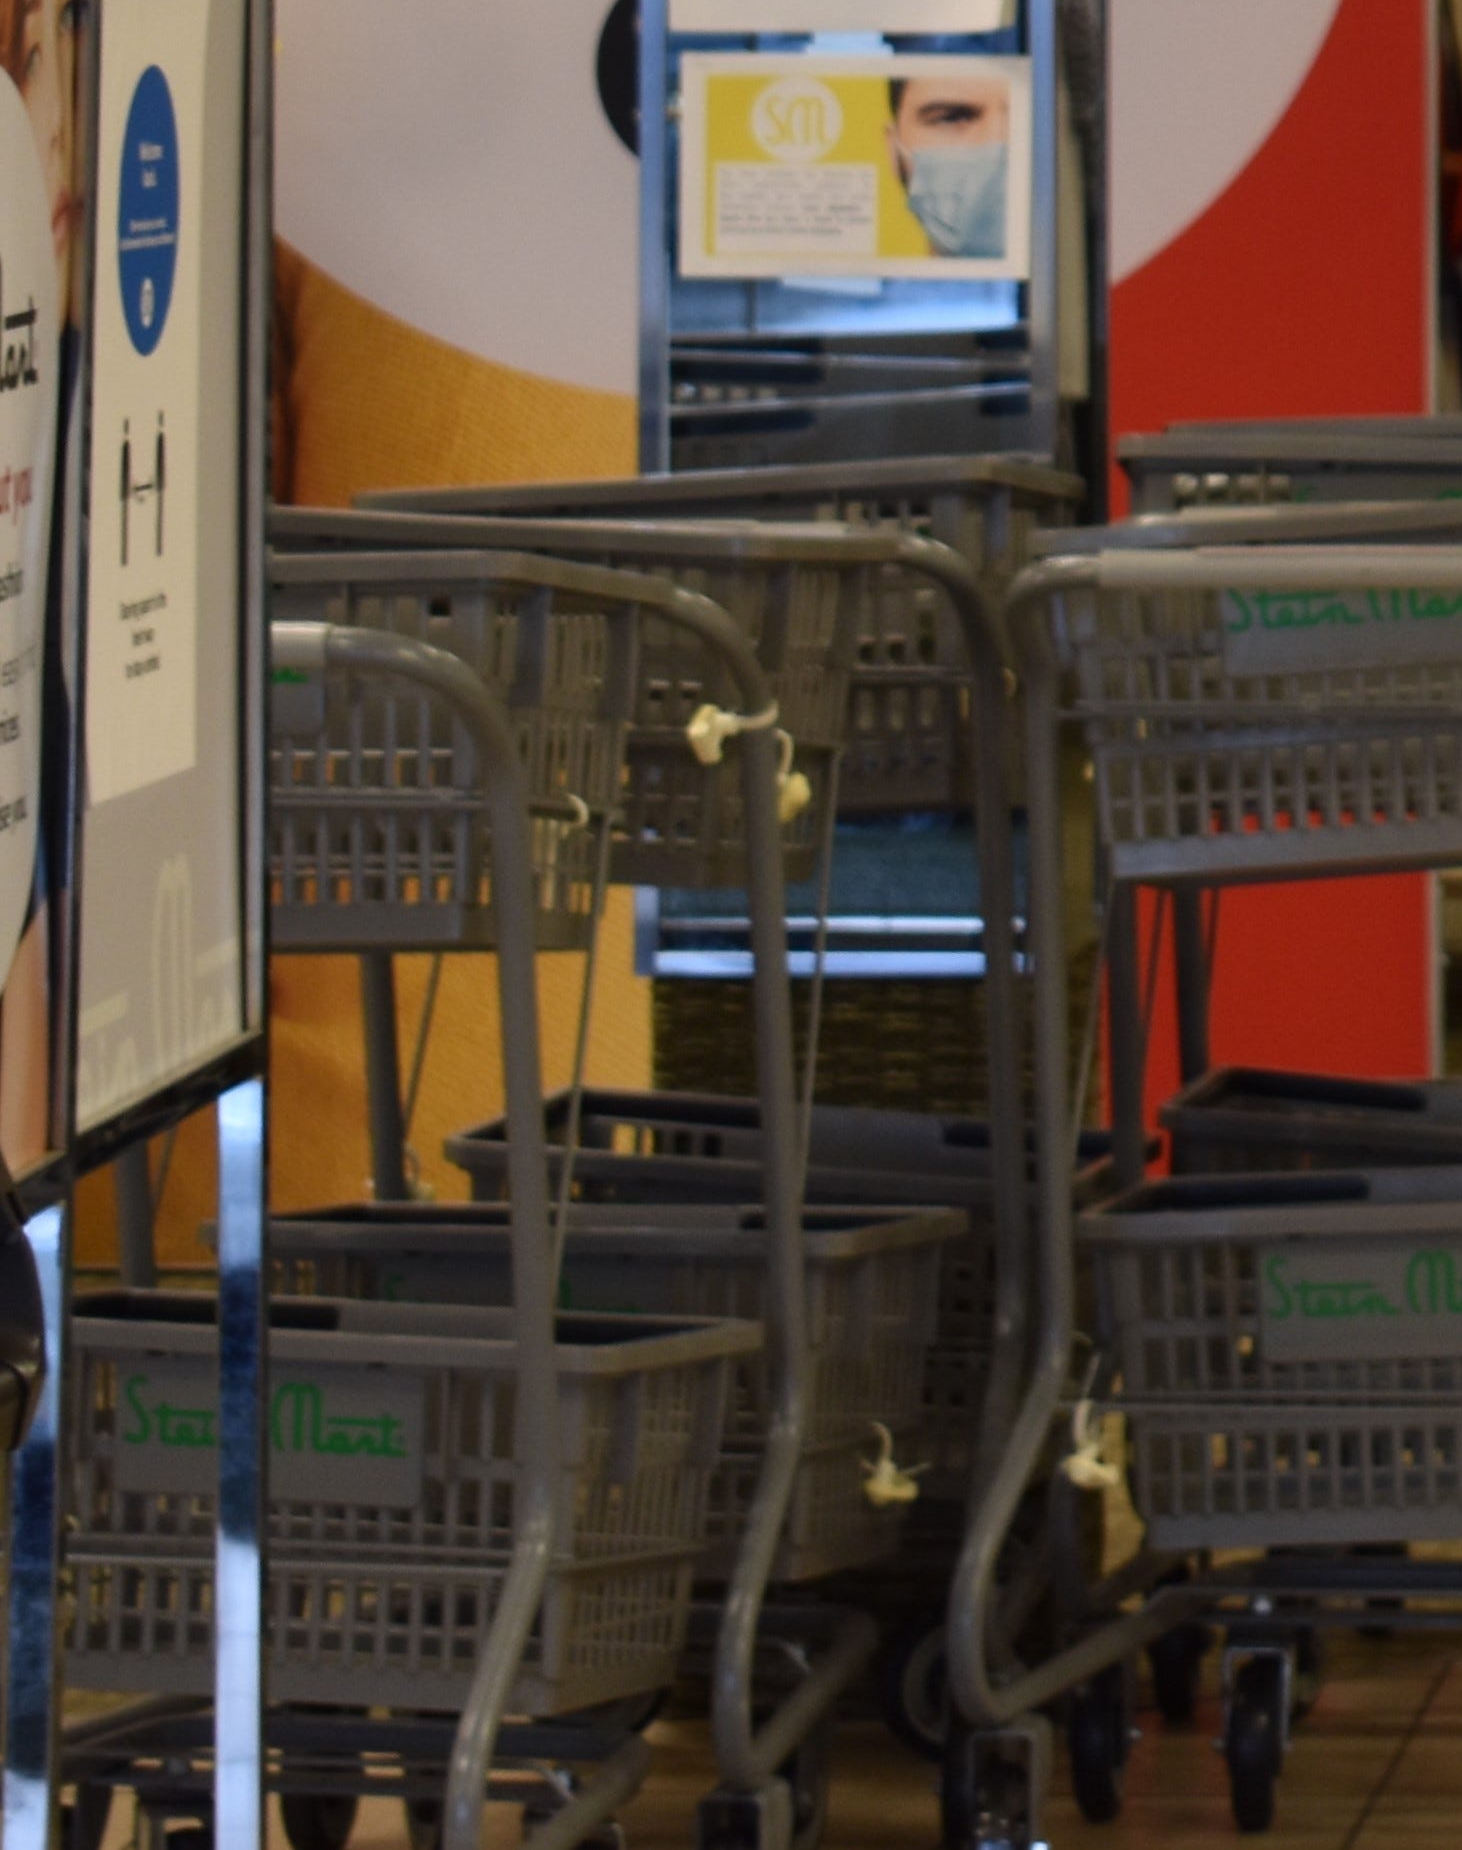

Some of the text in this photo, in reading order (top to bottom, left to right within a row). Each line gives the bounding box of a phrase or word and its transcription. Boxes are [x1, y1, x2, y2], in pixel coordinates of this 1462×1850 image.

[1227, 588, 1364, 633] Stein
[1263, 1254, 1400, 1321] Stein
[122, 1373, 408, 1459] Stei Mart
